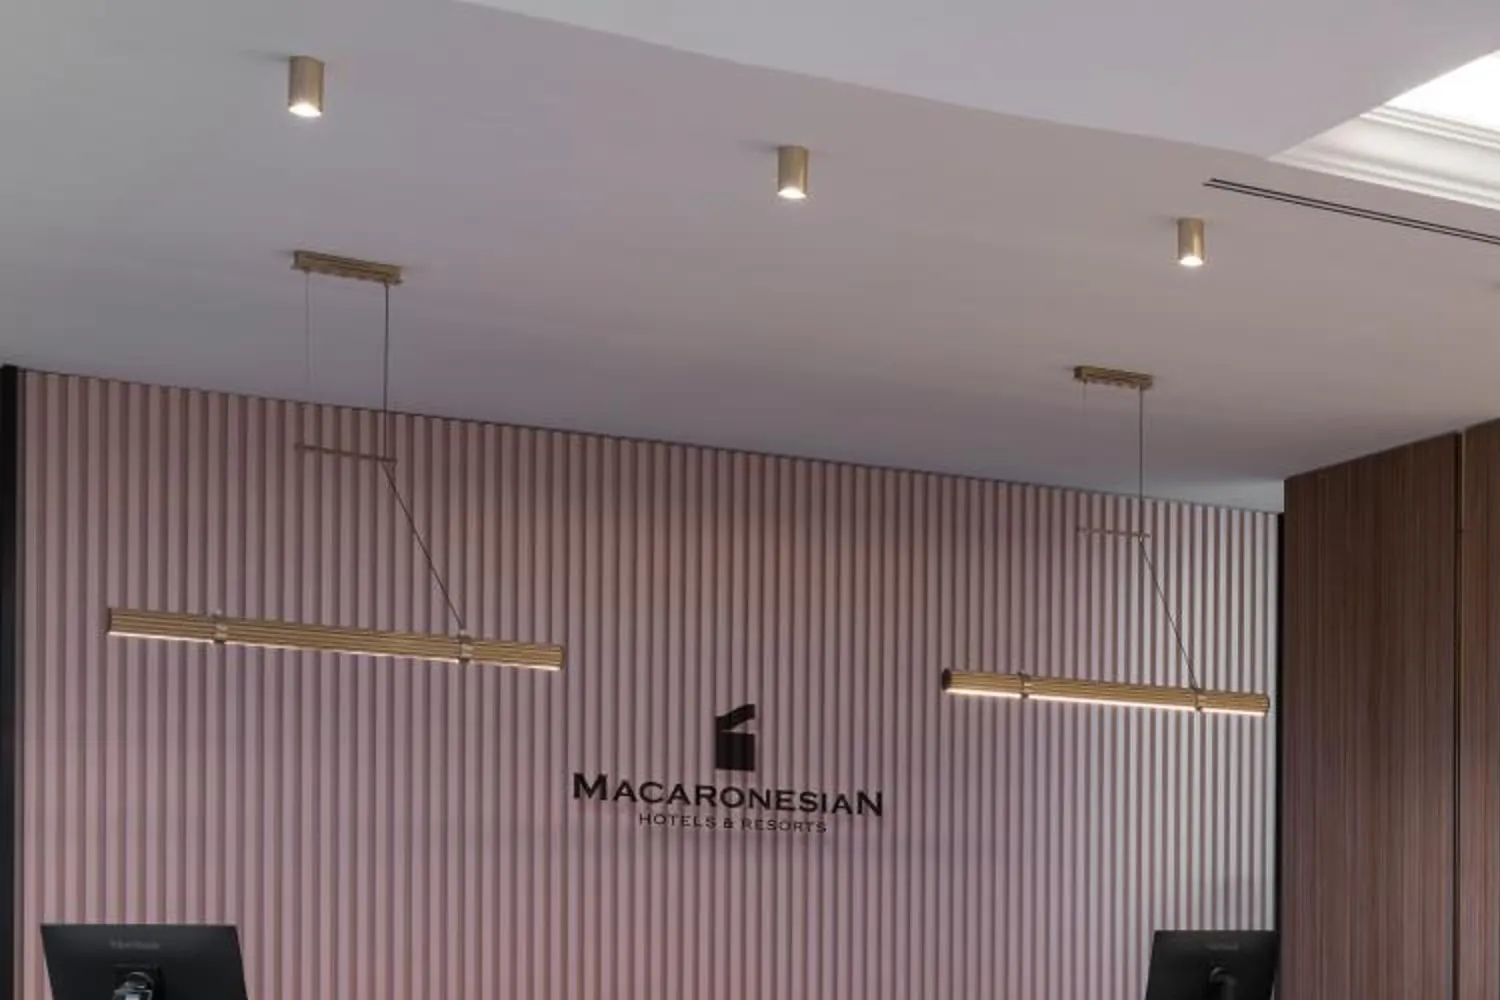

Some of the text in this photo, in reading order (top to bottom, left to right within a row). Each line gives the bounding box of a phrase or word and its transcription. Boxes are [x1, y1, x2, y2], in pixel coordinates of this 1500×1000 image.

[572, 771, 883, 818] MACARONESIAN
[639, 813, 827, 834] HOTELS & RESORTS
